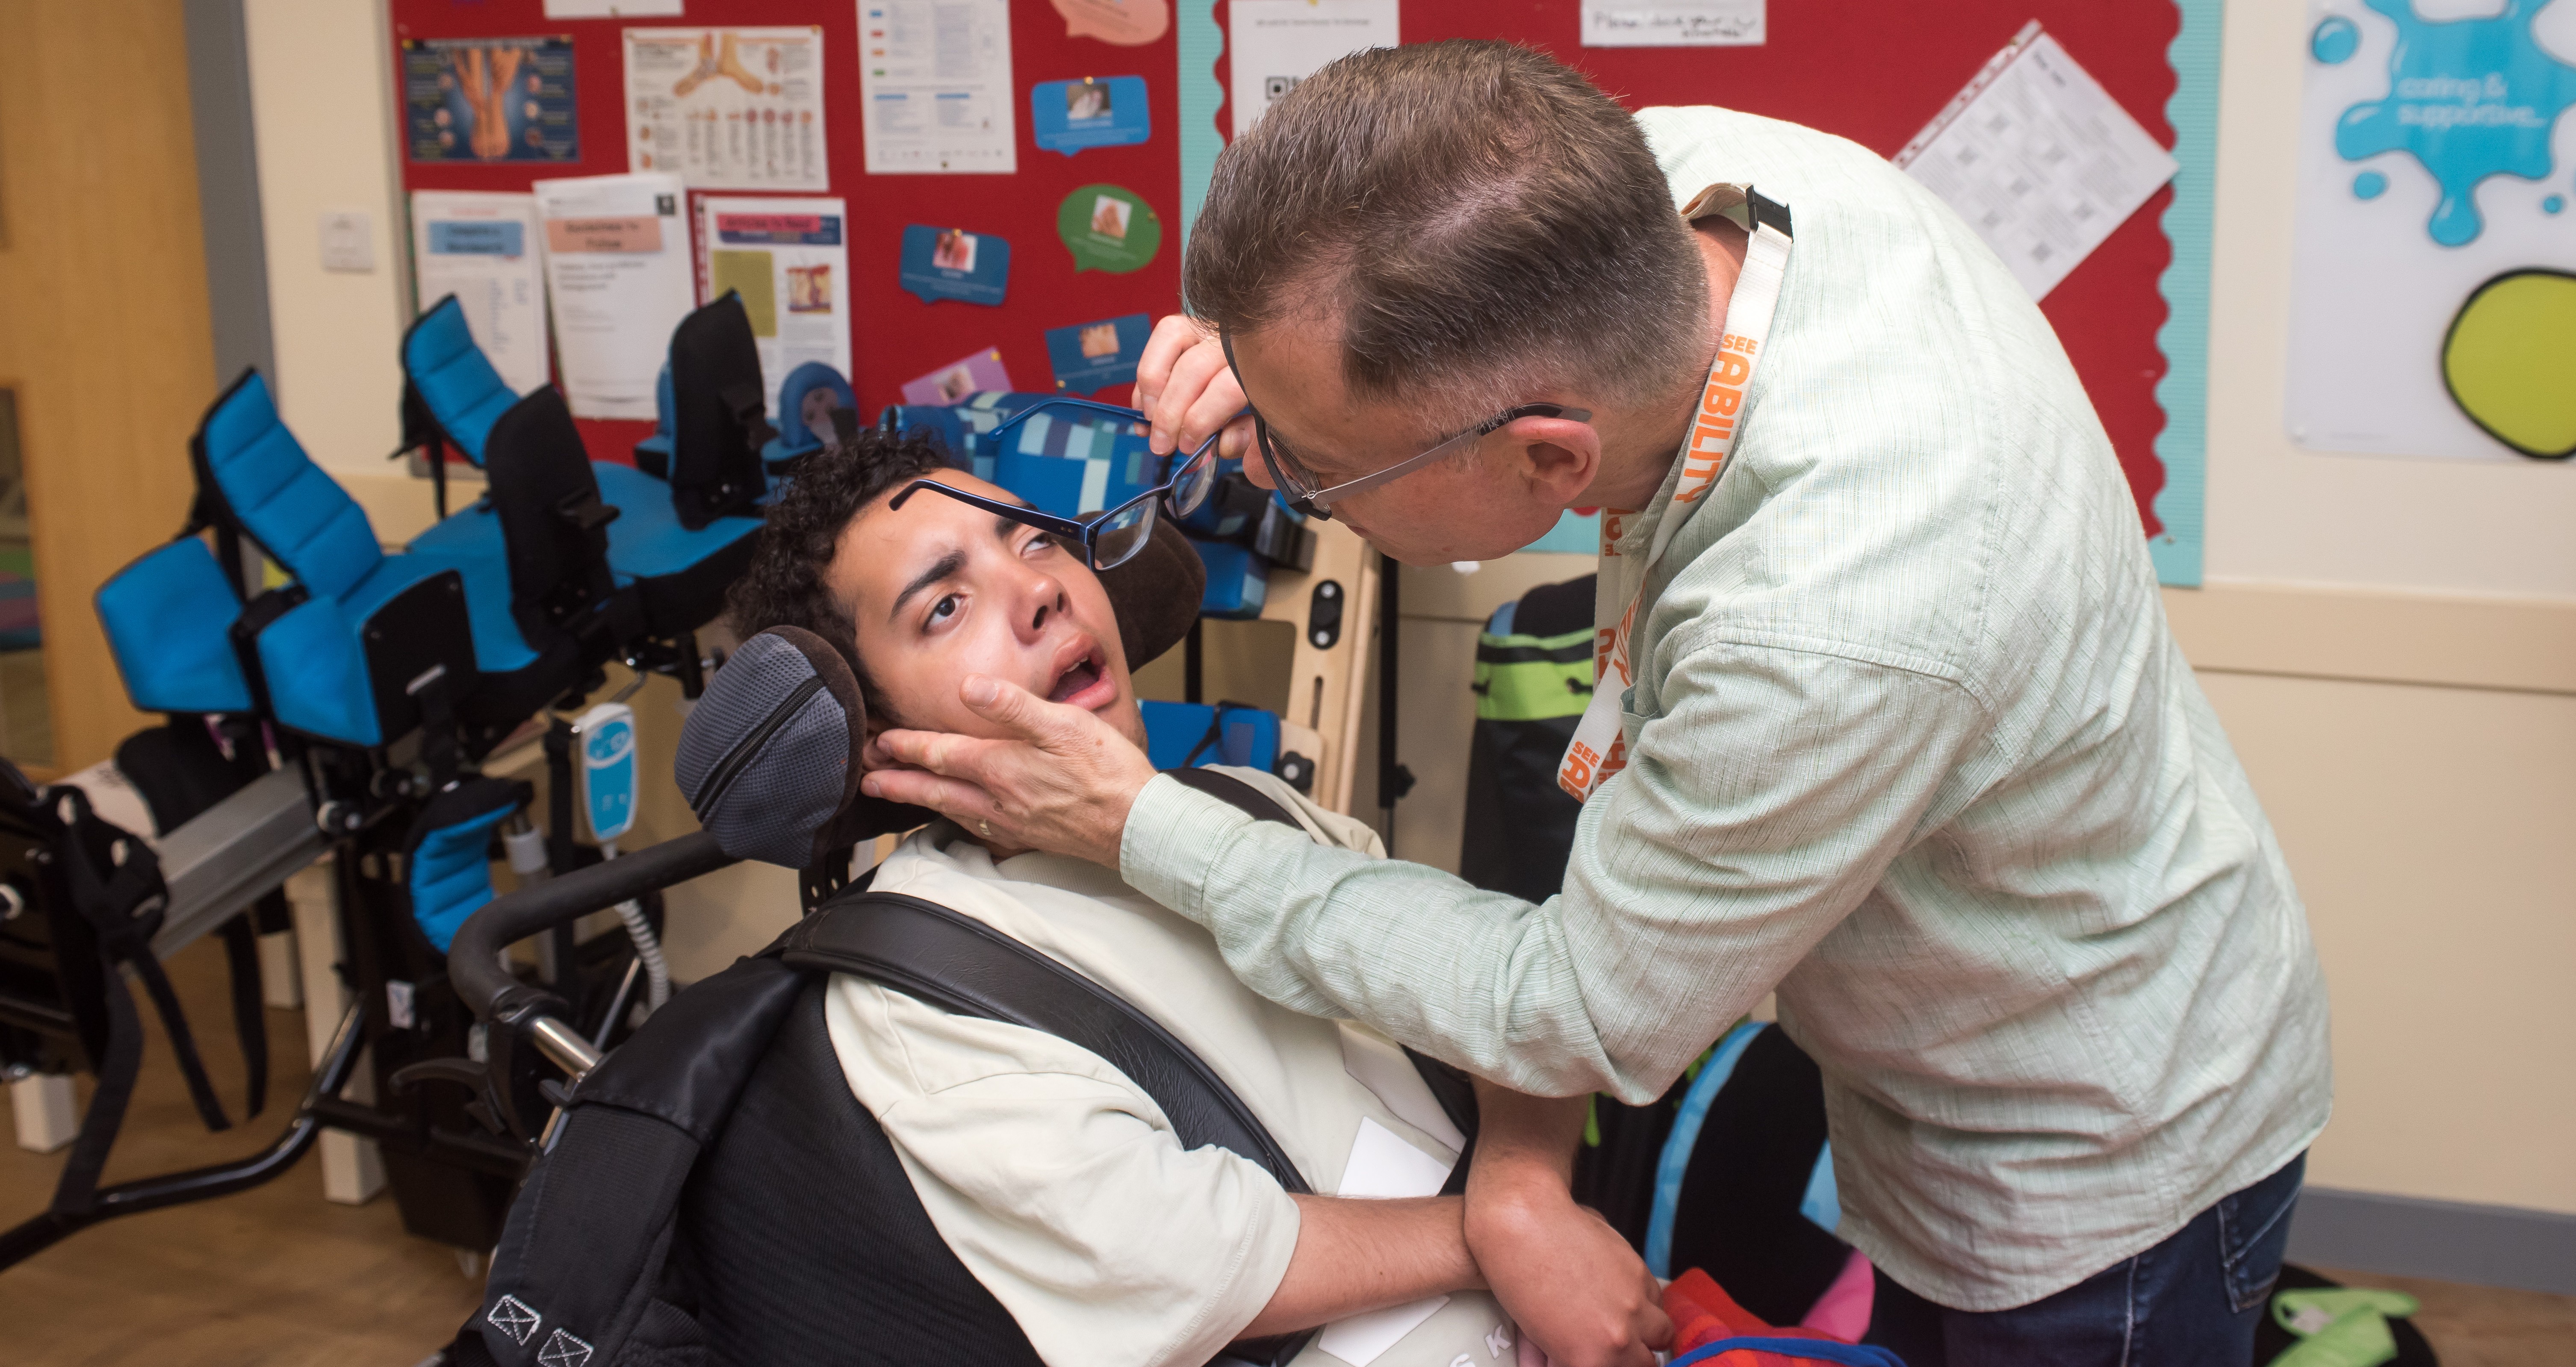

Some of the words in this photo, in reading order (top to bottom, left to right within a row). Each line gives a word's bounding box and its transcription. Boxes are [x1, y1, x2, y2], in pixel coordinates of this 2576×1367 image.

[2399, 77, 2480, 106] caring
[2484, 72, 2507, 98] &
[1721, 333, 1758, 355] SEE
[1674, 351, 1750, 504] ABILITY
[1572, 741, 1600, 768] SEE
